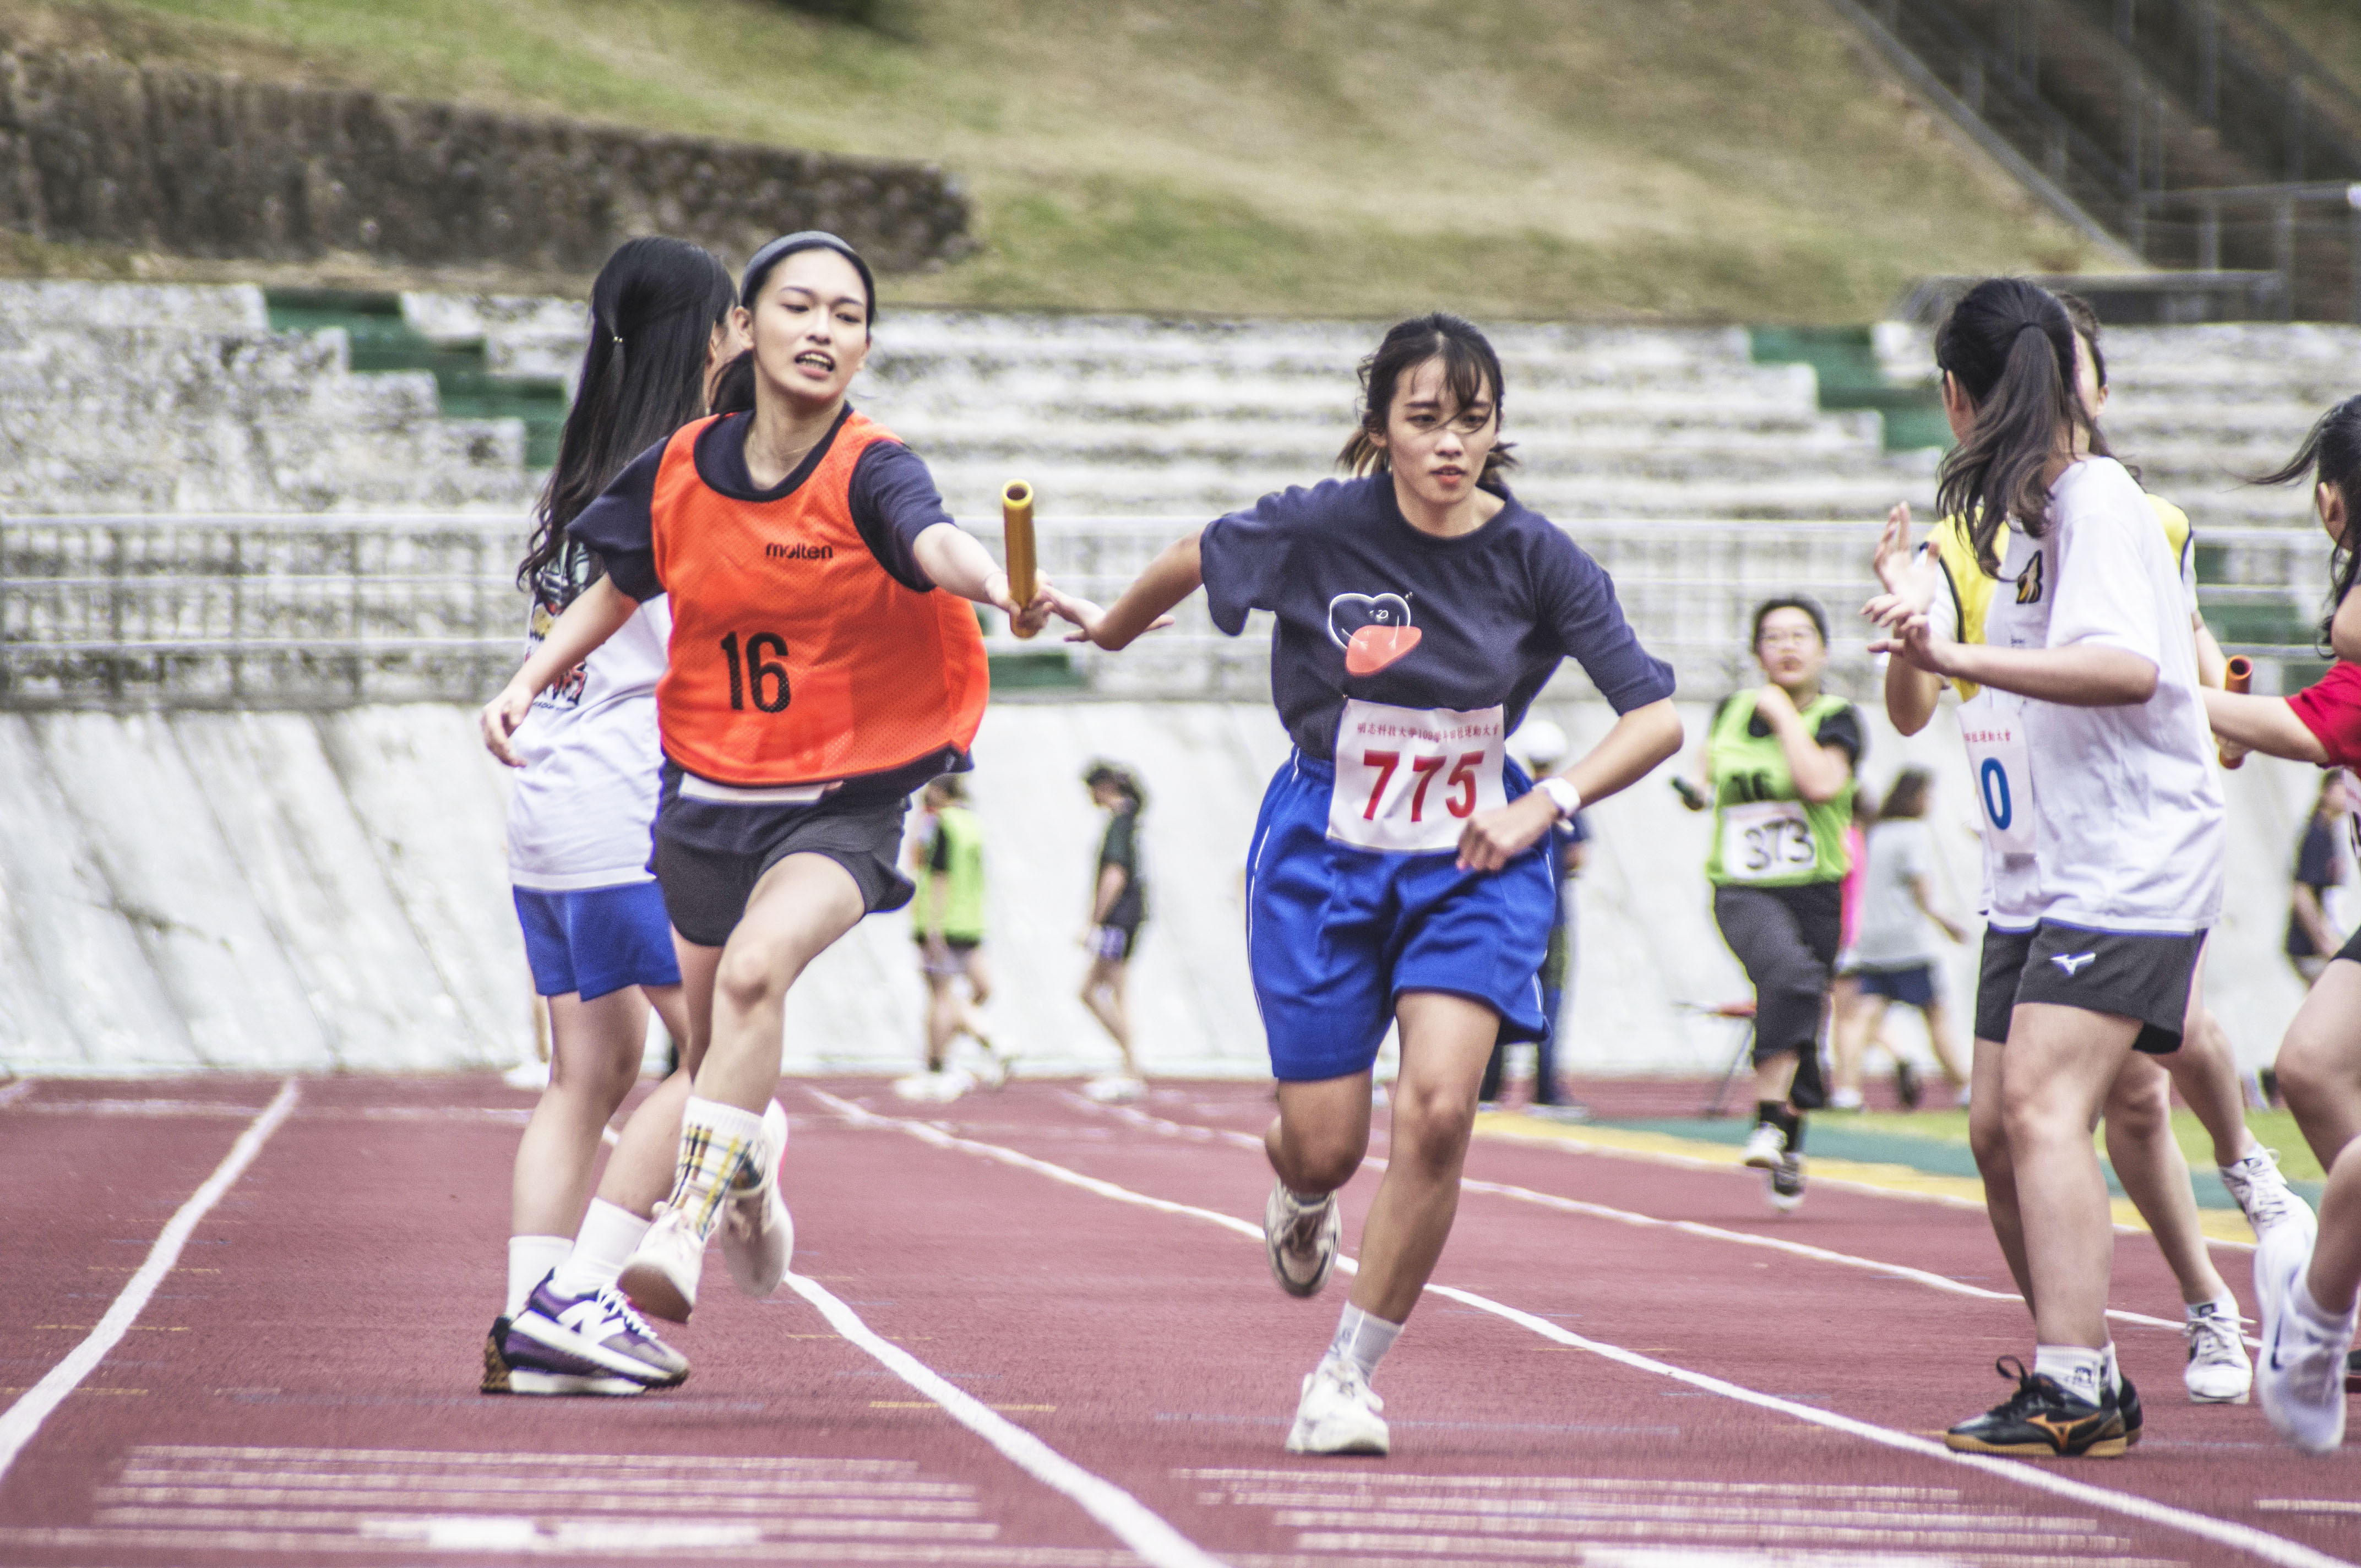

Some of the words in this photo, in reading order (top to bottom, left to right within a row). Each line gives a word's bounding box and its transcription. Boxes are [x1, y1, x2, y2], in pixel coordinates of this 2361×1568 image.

[766, 542, 833, 559] molten
[721, 631, 791, 712] 16
[1363, 749, 1485, 822] 775
[1981, 756, 2012, 830] 0
